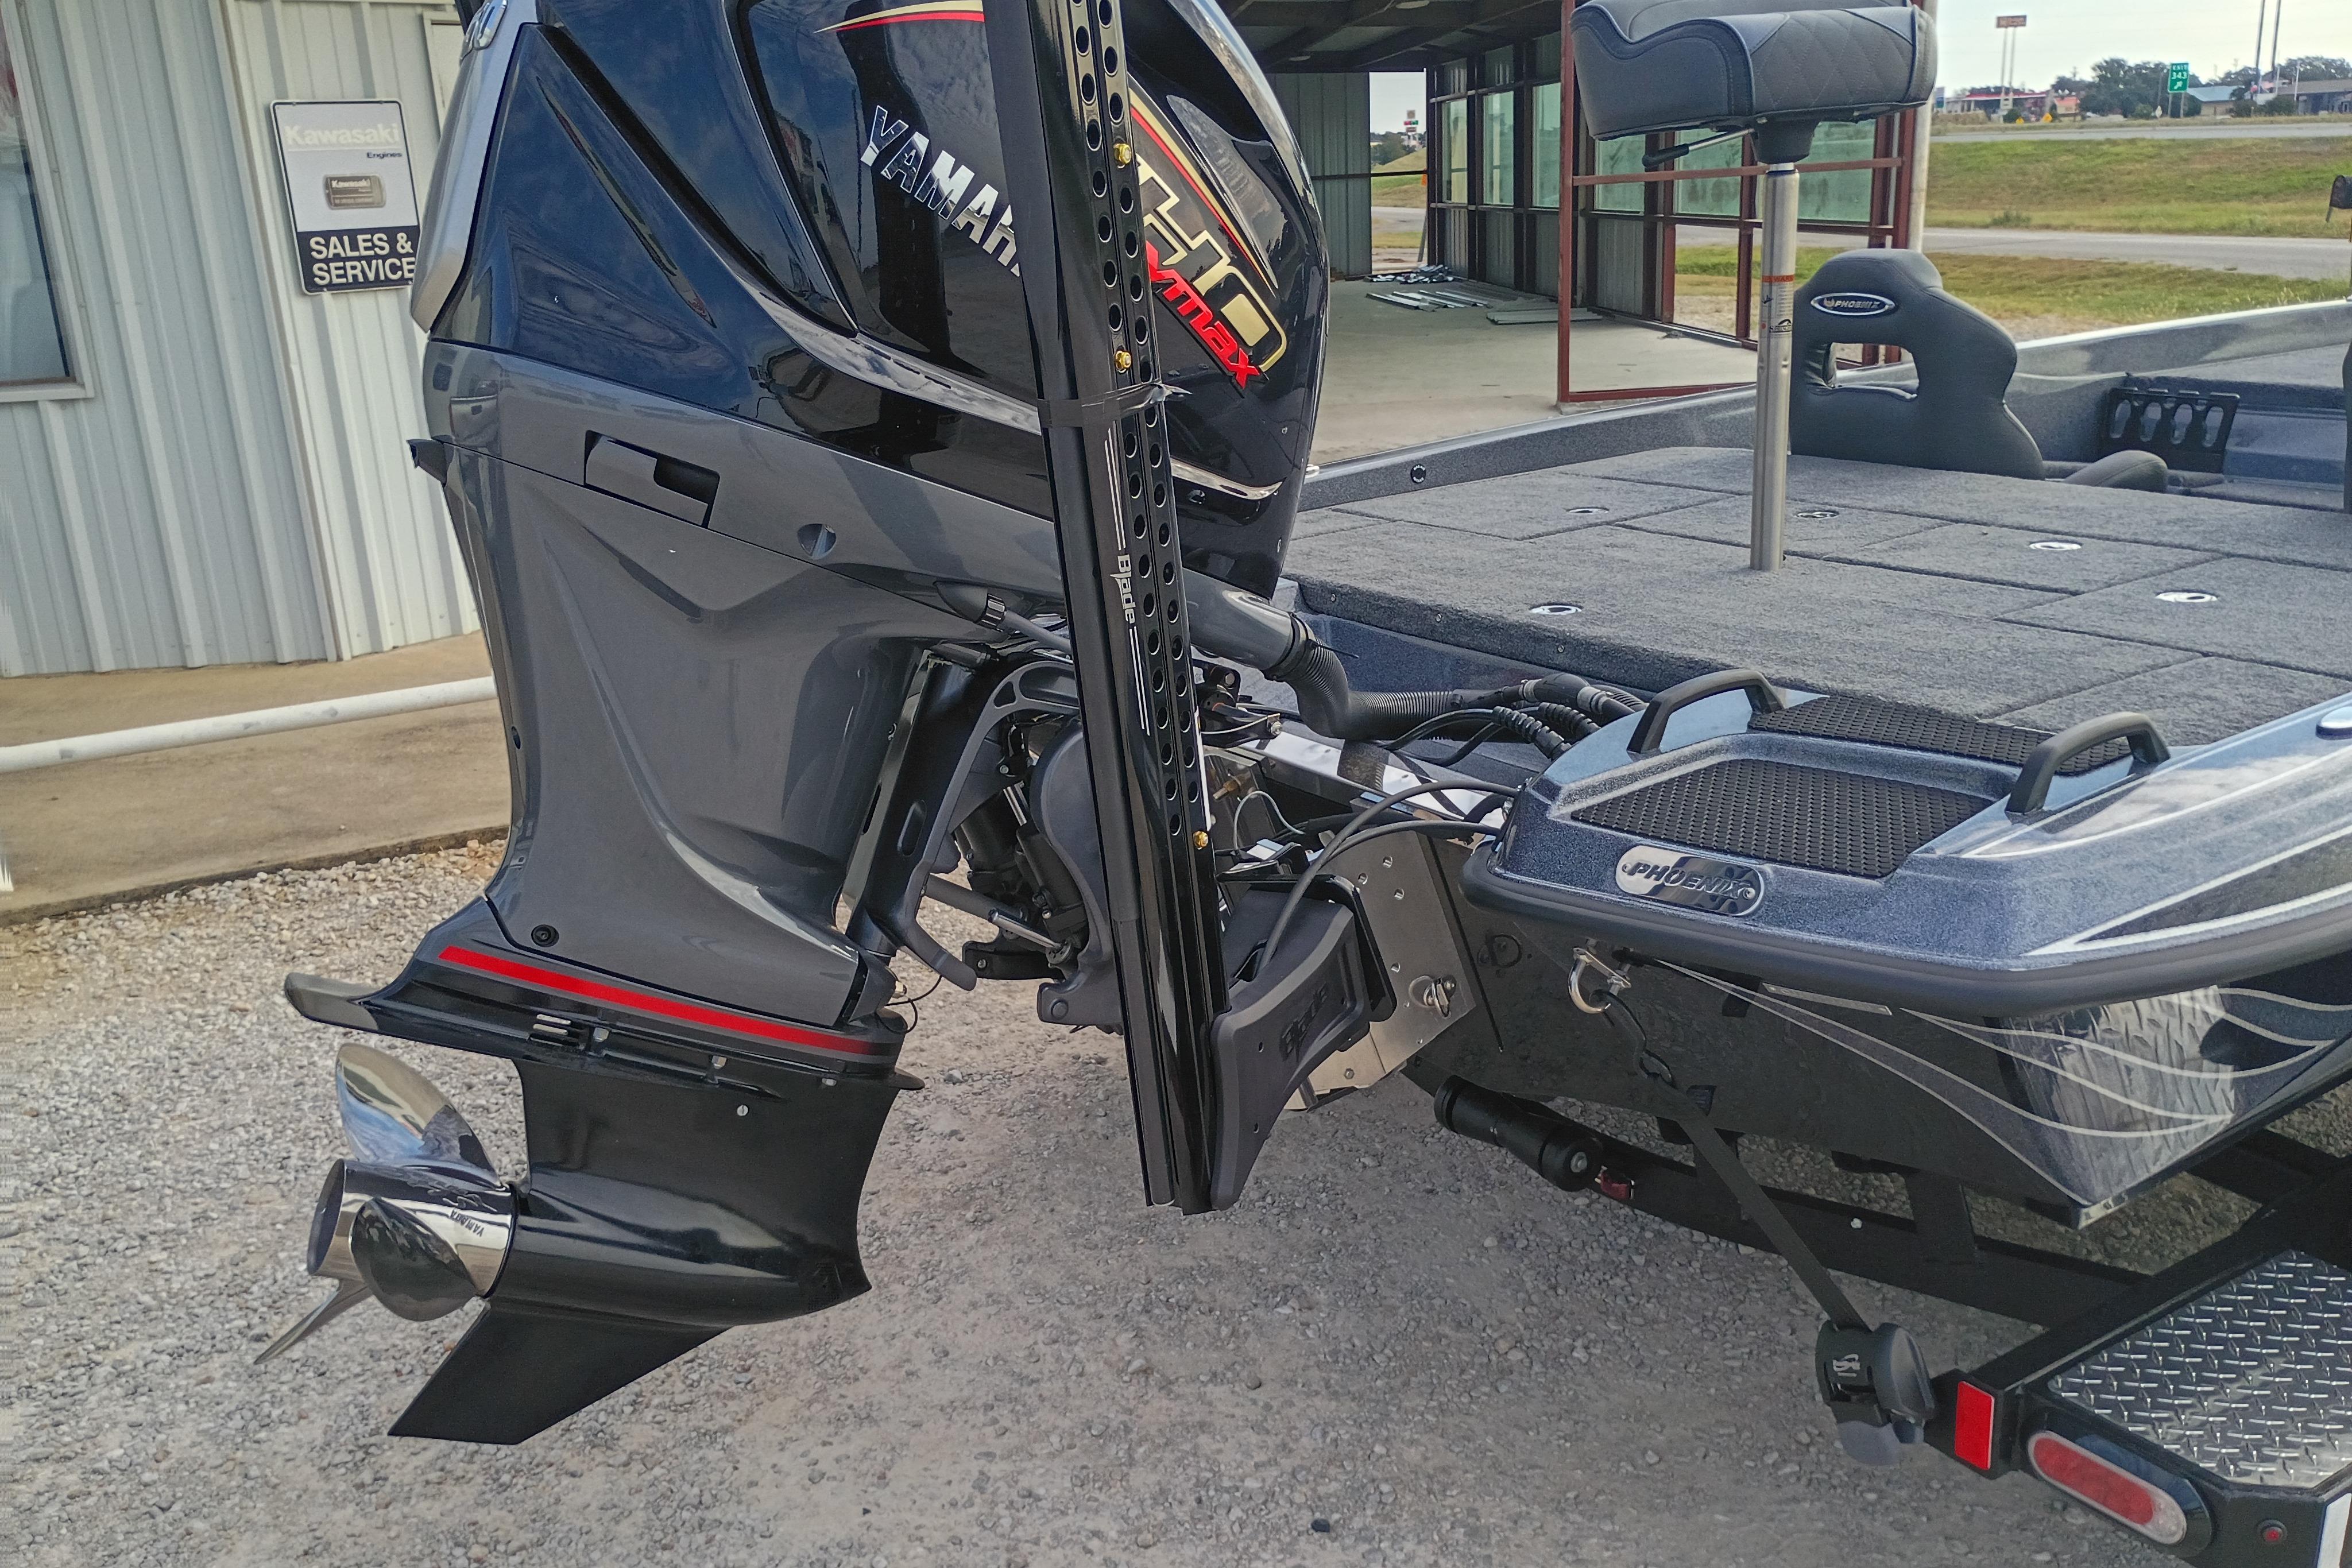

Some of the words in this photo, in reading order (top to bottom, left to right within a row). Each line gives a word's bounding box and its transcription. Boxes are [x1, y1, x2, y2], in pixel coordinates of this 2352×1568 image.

[285, 123, 400, 145] Kawasaki
[860, 105, 1021, 277] YAMAH
[310, 233, 390, 259] SALES
[396, 233, 413, 254] &
[312, 257, 416, 285] SERVICE
[1835, 300, 1881, 309] PHOENIX
[1109, 554, 1136, 624] Blade
[1627, 861, 1751, 899] PHOENIX
